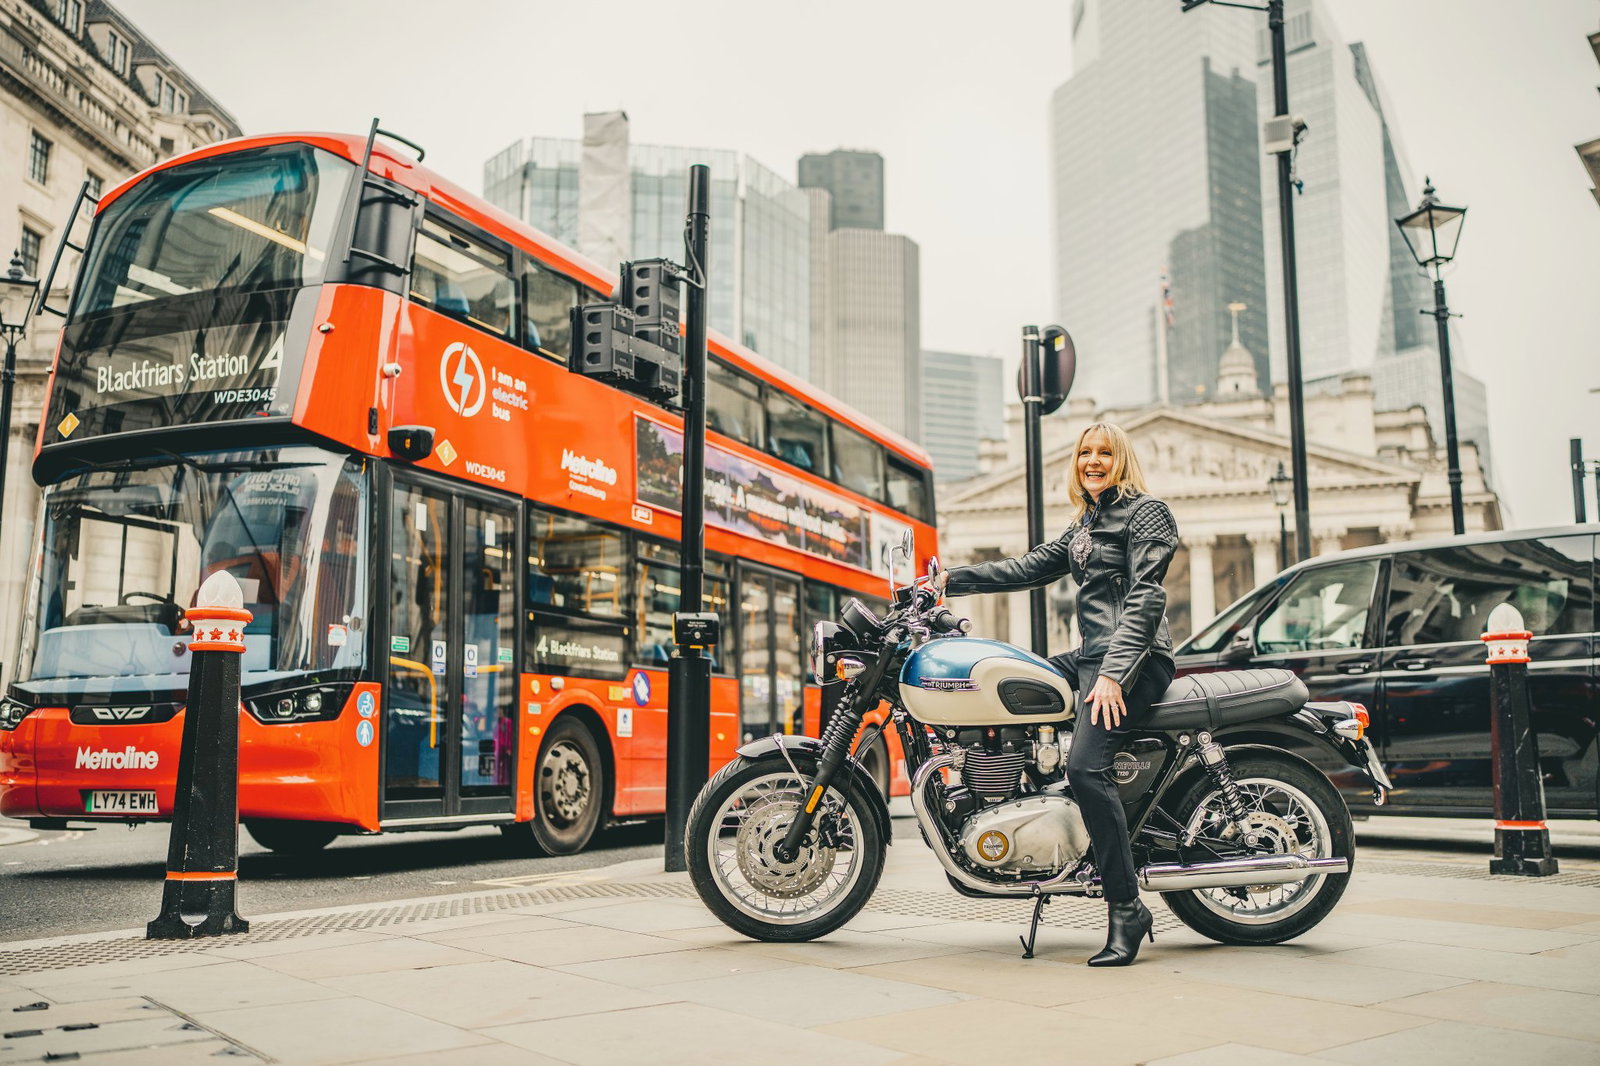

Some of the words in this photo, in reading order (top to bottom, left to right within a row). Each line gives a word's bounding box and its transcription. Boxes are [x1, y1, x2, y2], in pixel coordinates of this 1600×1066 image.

[97, 360, 184, 393] Blackfriars
[189, 352, 248, 381] Station
[258, 332, 284, 390] 4
[491, 366, 497, 381] I
[497, 371, 514, 388] am
[514, 378, 527, 393] an
[214, 388, 278, 404] WDE3045
[492, 386, 529, 411] electric
[492, 402, 511, 422] bus
[465, 459, 506, 483] WDE3045
[561, 448, 617, 486] Metroline
[536, 634, 549, 658] 4
[550, 640, 592, 658] Blackfriars
[592, 645, 619, 661] Station
[931, 681, 966, 689] TRIUMPH
[75, 746, 159, 770] Metroline
[94, 793, 126, 810] LY74
[129, 793, 156, 810] EWH
